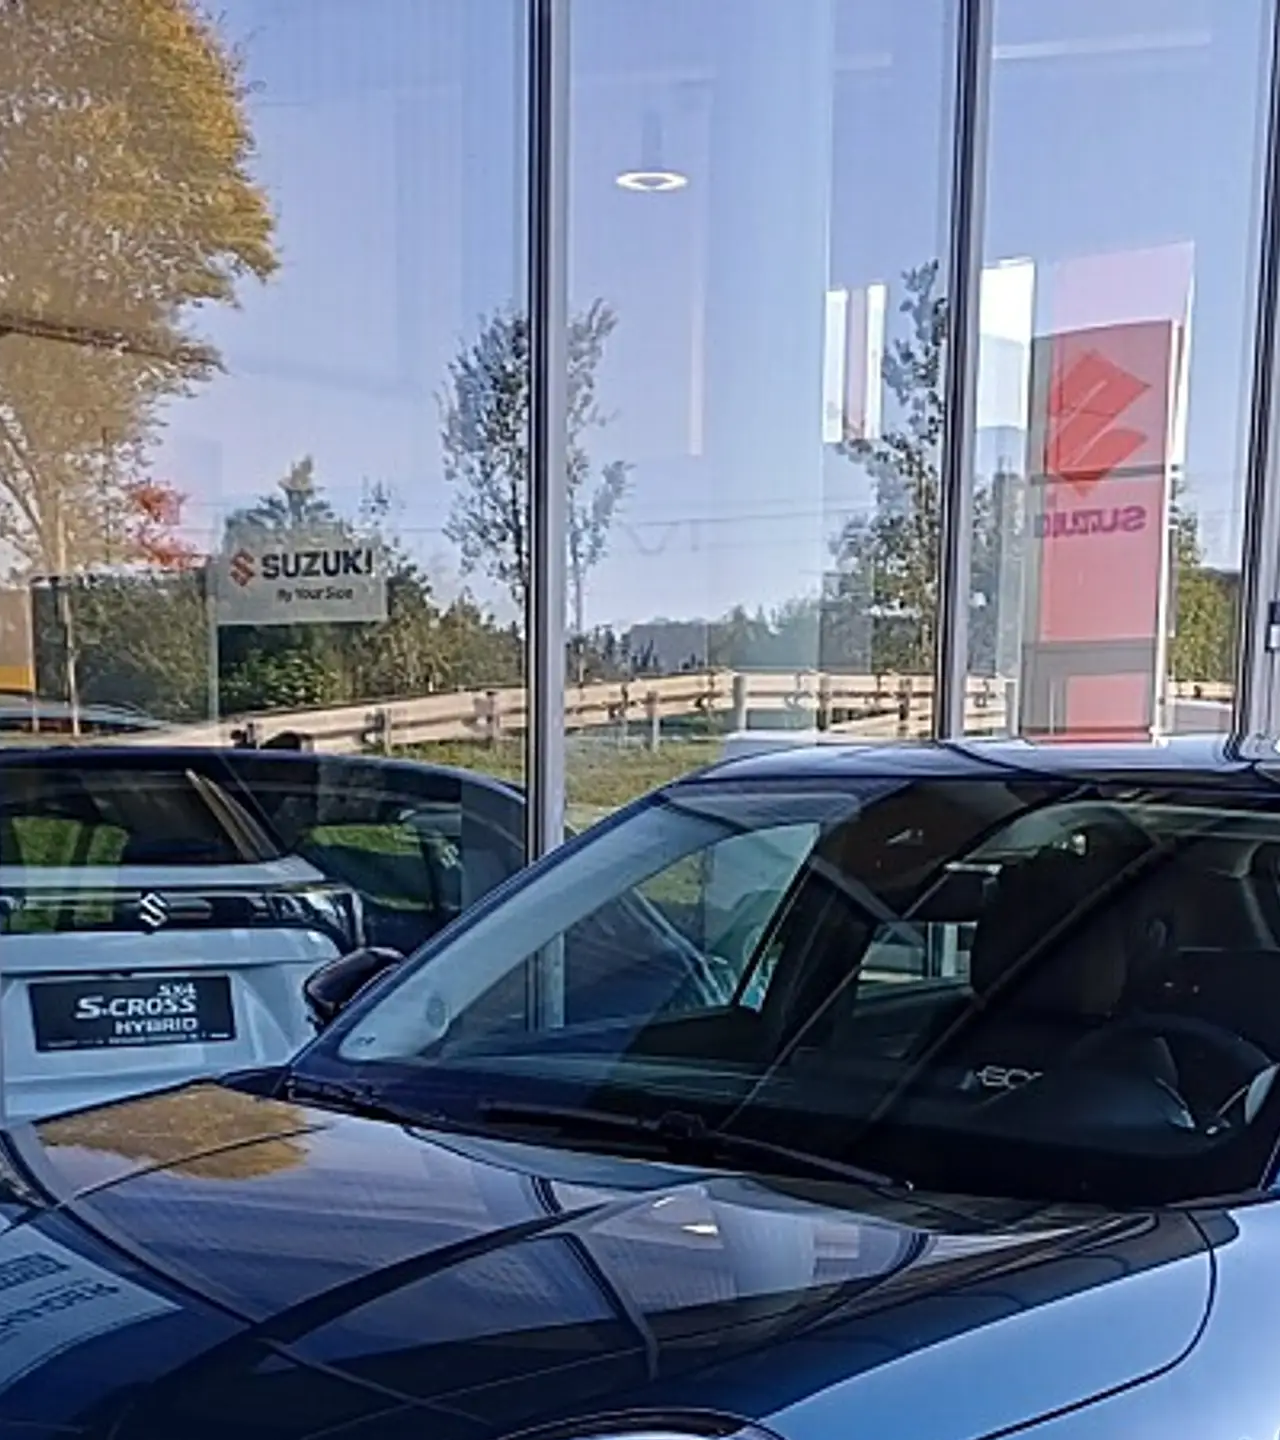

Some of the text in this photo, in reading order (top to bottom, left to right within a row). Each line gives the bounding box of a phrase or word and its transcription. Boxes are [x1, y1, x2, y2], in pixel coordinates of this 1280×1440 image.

[261, 549, 374, 580] SUZUKI
[294, 587, 324, 601] Your
[114, 1016, 199, 1035] HYBRID
